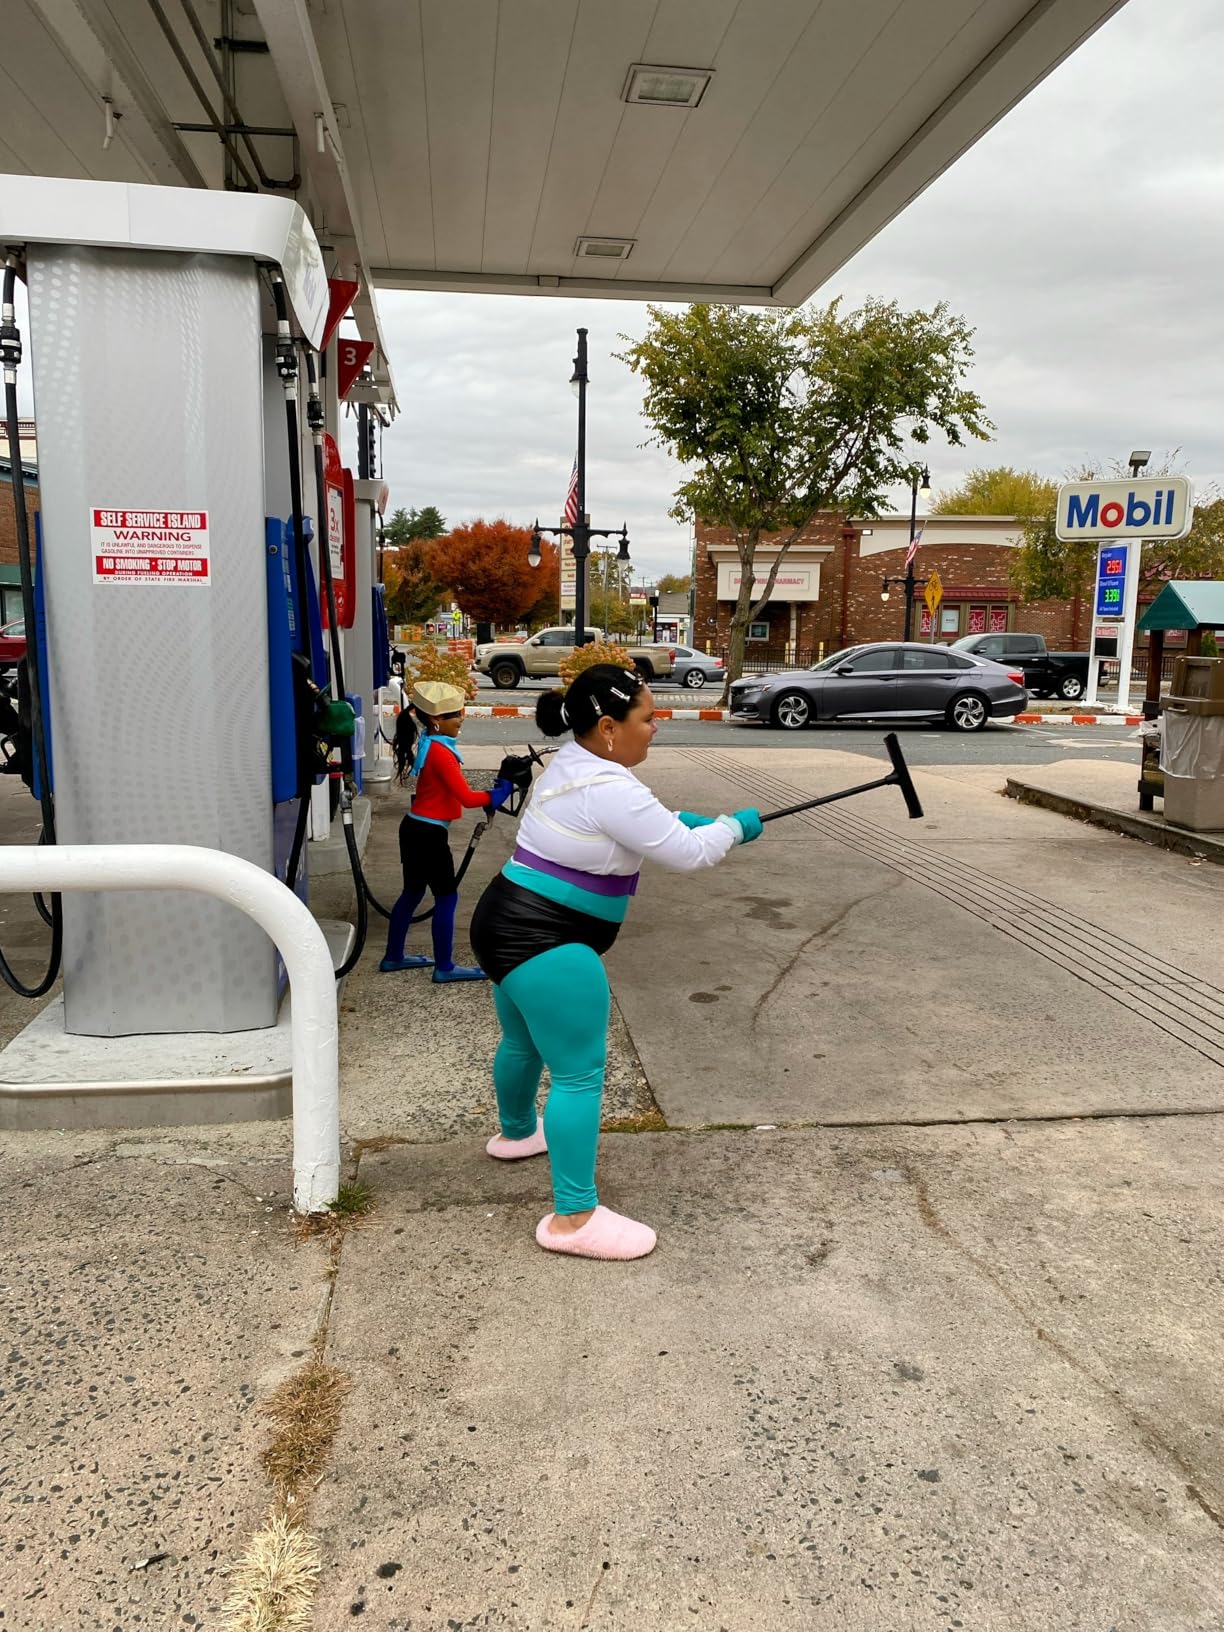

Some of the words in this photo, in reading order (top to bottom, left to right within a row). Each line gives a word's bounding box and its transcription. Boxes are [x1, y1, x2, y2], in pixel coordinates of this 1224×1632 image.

[344, 347, 357, 366] 3
[1067, 490, 1175, 528] Mobil
[100, 511, 123, 526] SELF
[126, 512, 165, 528] SERVICE
[168, 514, 201, 528] ISLAND
[113, 530, 192, 542] WARNING
[102, 557, 114, 569] NO
[115, 558, 150, 570] SMOKING
[157, 559, 176, 571] STOP
[177, 560, 202, 571] MOTOR
